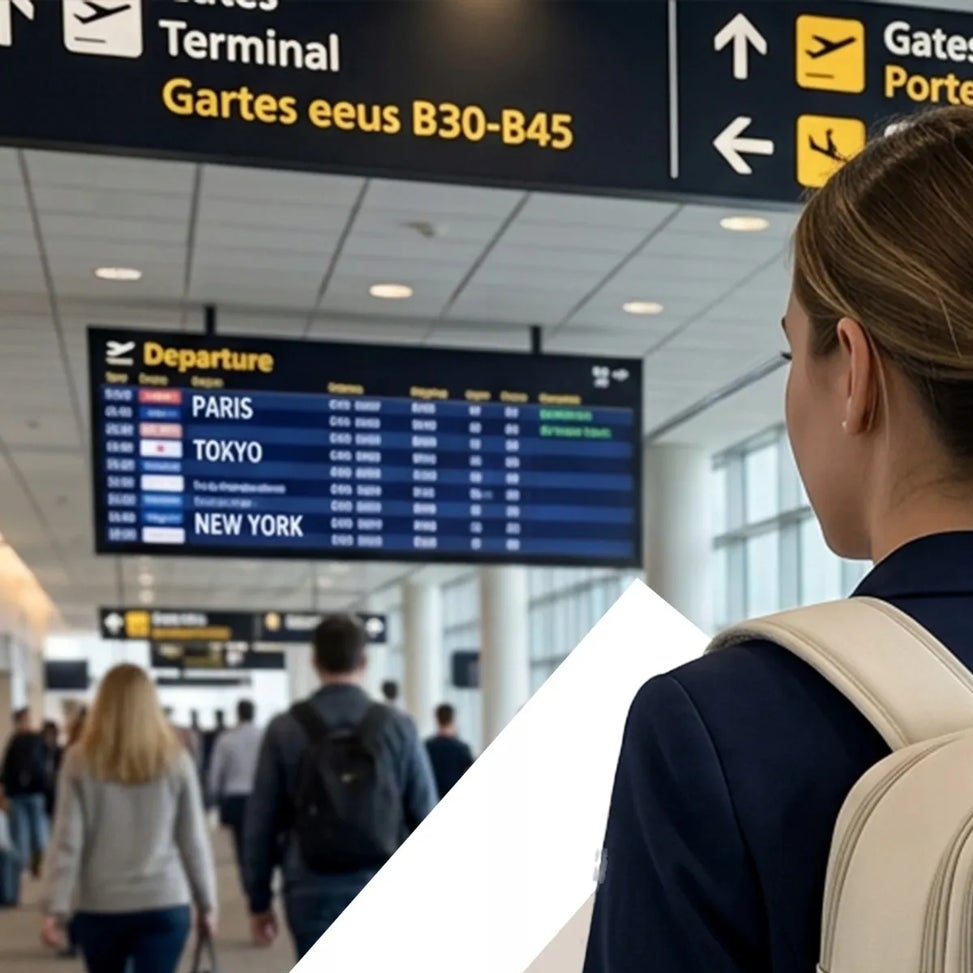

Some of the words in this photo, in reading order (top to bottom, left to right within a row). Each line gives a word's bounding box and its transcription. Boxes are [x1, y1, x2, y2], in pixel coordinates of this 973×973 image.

[158, 19, 340, 72] Terminal
[162, 77, 298, 124] Gartes
[308, 98, 401, 134] eeus
[413, 100, 574, 150] B30-B45
[143, 342, 275, 373] Departure
[192, 395, 254, 419] PARIS
[193, 439, 263, 463] TOKYO
[194, 512, 242, 536] NEW
[248, 514, 304, 537] YORK
